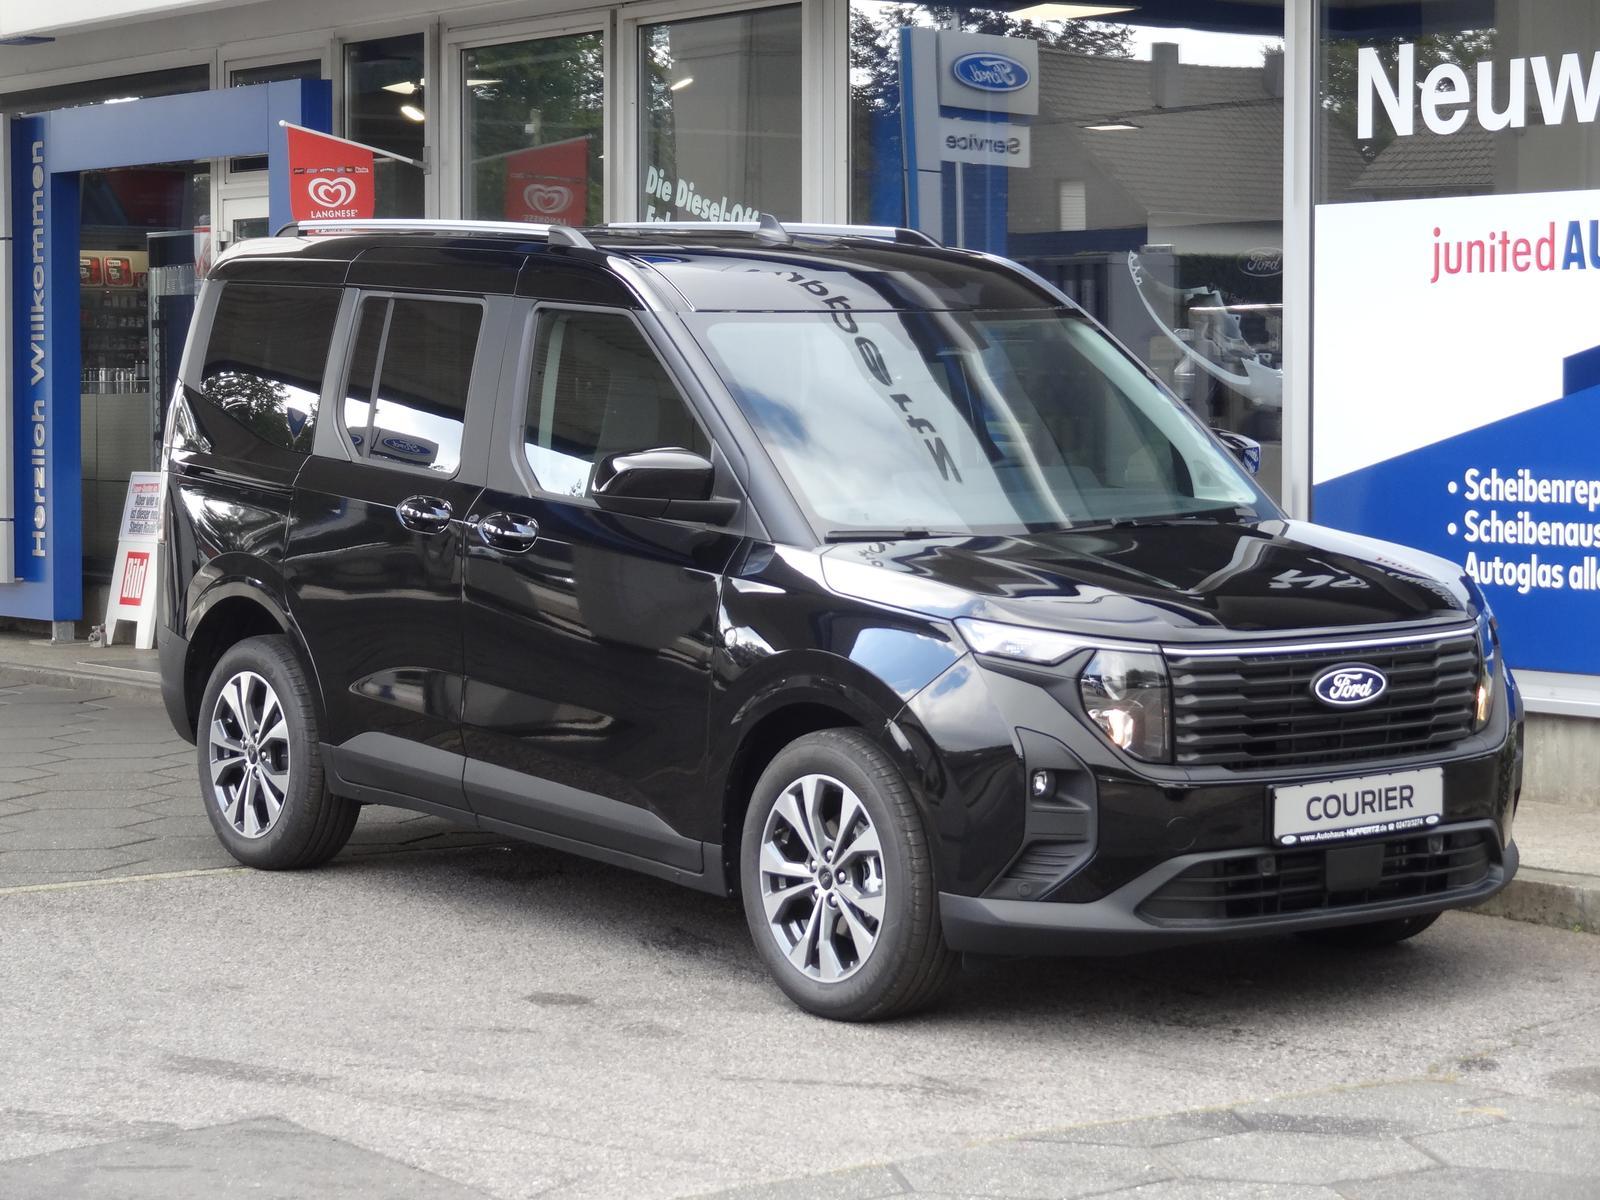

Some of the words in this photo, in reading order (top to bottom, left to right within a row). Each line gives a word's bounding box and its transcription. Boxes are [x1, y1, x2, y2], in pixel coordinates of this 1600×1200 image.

[1357, 42, 1600, 140] Neuw
[645, 165, 672, 202] Die
[311, 209, 356, 219] LANGNESE
[30, 141, 45, 386] Willkommen
[31, 399, 46, 557] Herzlich
[1463, 467, 1600, 512] Scheibenrep
[1463, 509, 1600, 548] Scheibenaus
[121, 557, 148, 598] Bild
[1465, 551, 1564, 594] Autoglas
[1568, 556, 1600, 591] all
[1306, 784, 1414, 821] COURIER
